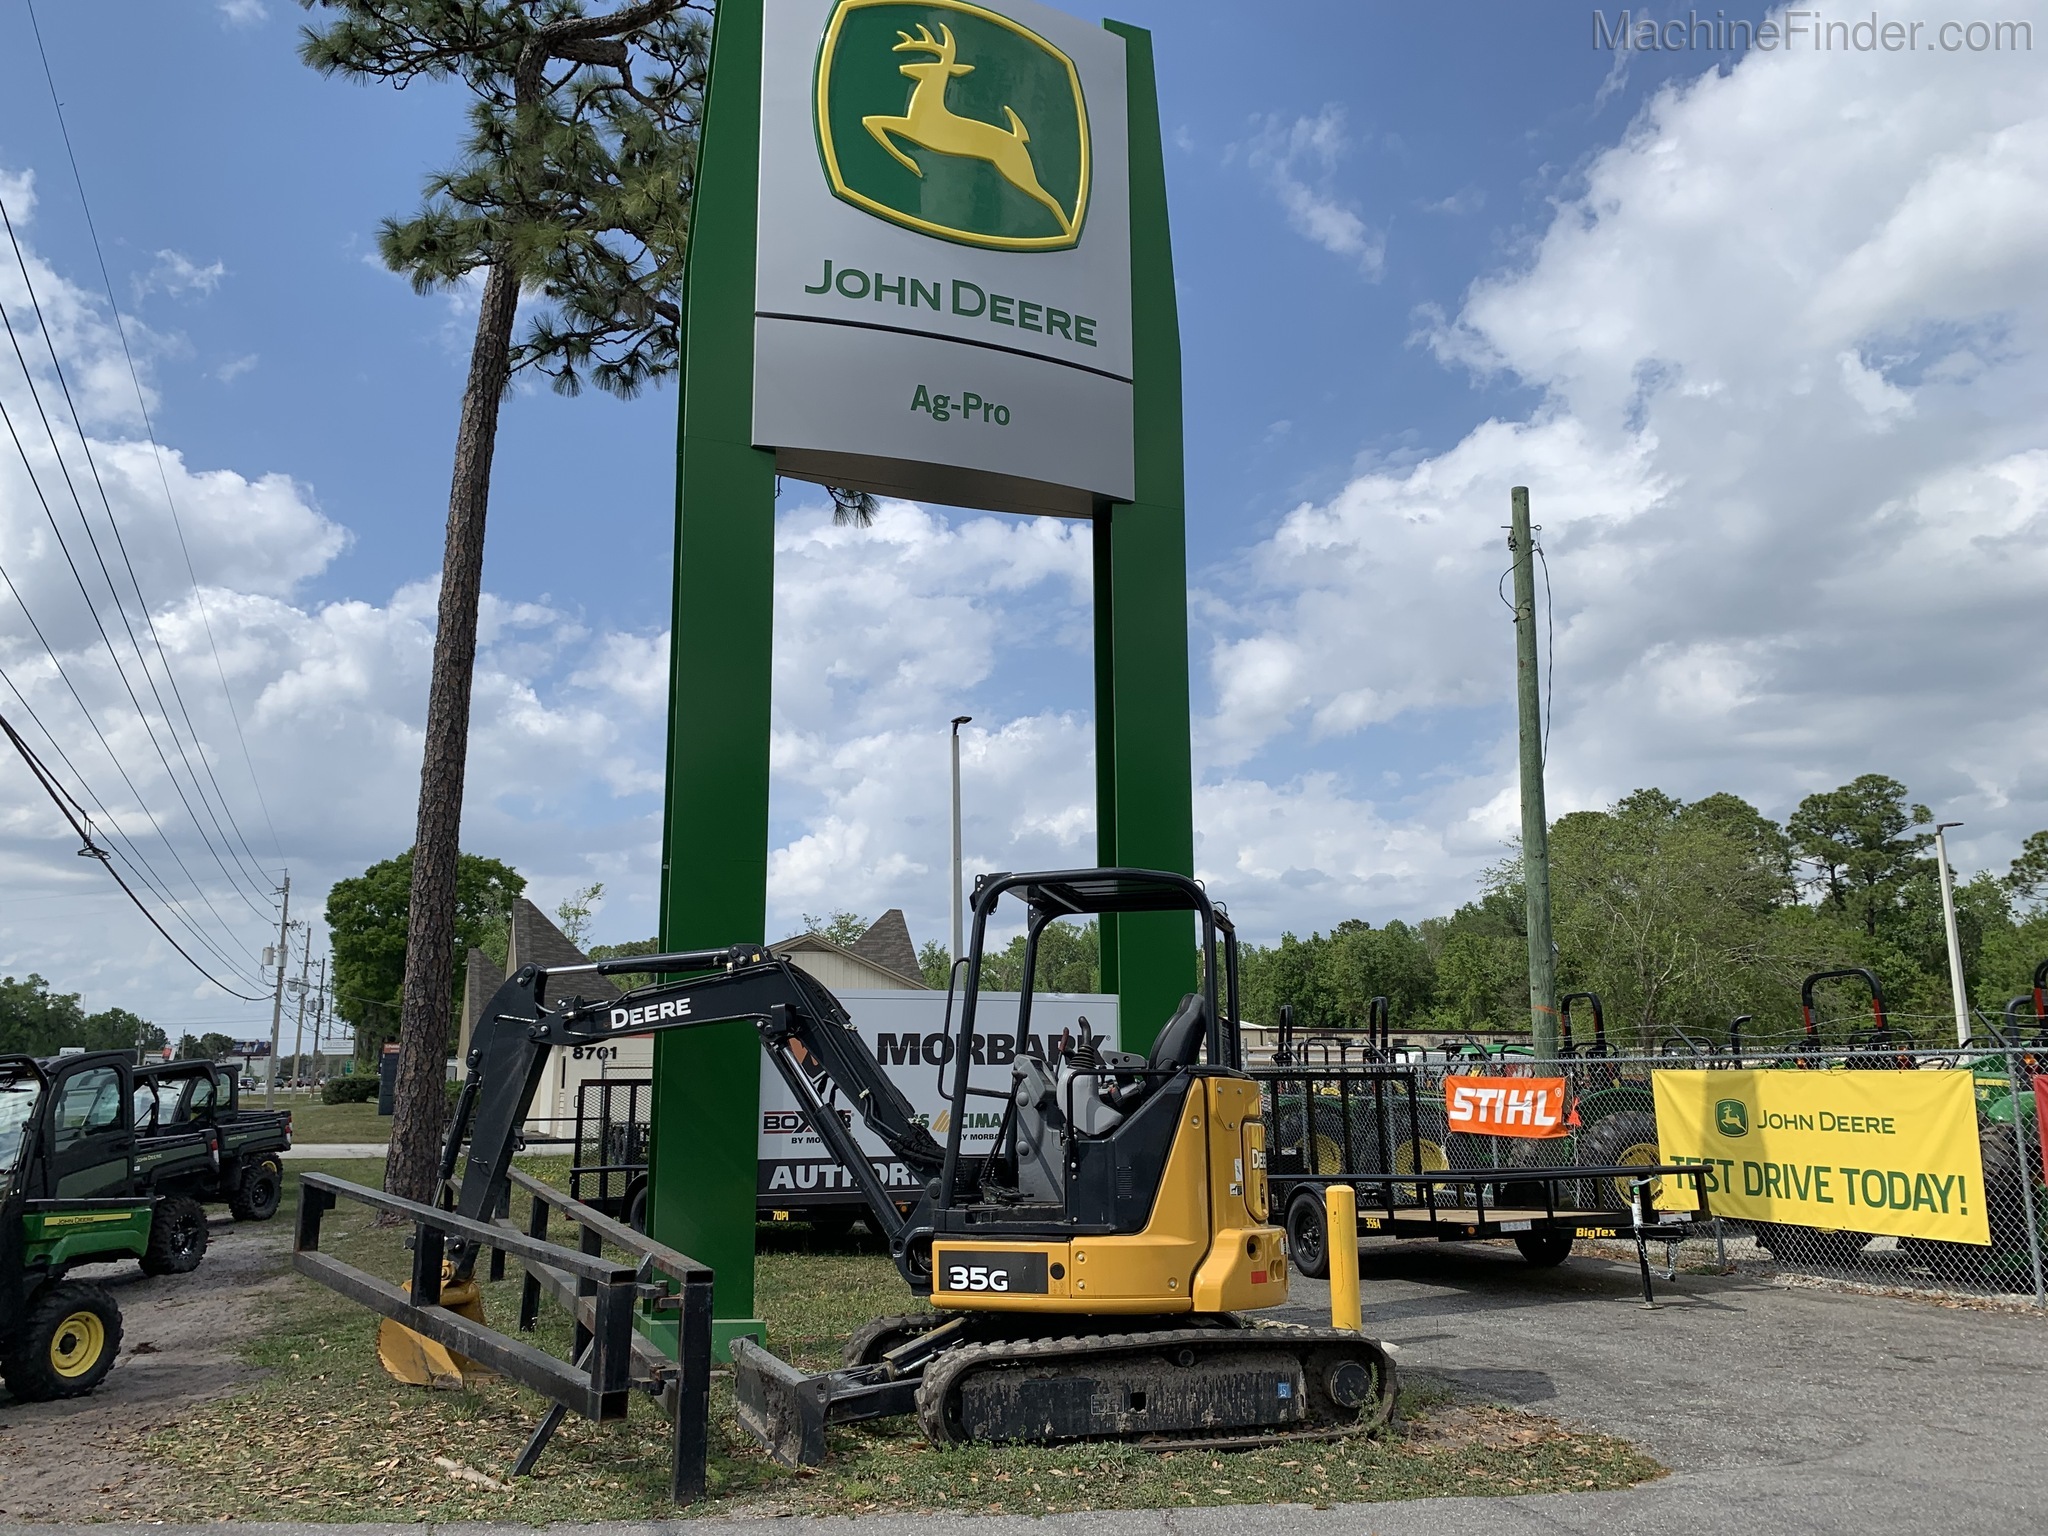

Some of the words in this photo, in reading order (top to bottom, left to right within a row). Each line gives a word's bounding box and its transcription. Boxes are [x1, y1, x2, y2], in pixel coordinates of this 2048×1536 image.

[804, 259, 941, 311] JOHN
[952, 279, 1098, 347] DEERE
[910, 384, 1011, 426] Ag-Pro
[610, 997, 692, 1029] DEERE
[572, 1046, 617, 1060] 8701
[1449, 1087, 1557, 1126] STIHL
[1757, 1109, 1814, 1131] JOHN
[1820, 1111, 1896, 1135] DEERE
[135, 1155, 148, 1163] JOHN
[148, 1153, 162, 1161] DEERE
[1669, 1155, 1735, 1194] TEST
[1742, 1161, 1834, 1204] DRIVE
[1839, 1167, 1968, 1216] TODAY!
[56, 1217, 74, 1225] JOHN
[74, 1216, 95, 1224] DEERE
[1575, 1227, 1617, 1240] BigTex
[949, 1265, 1009, 1291] 35G
